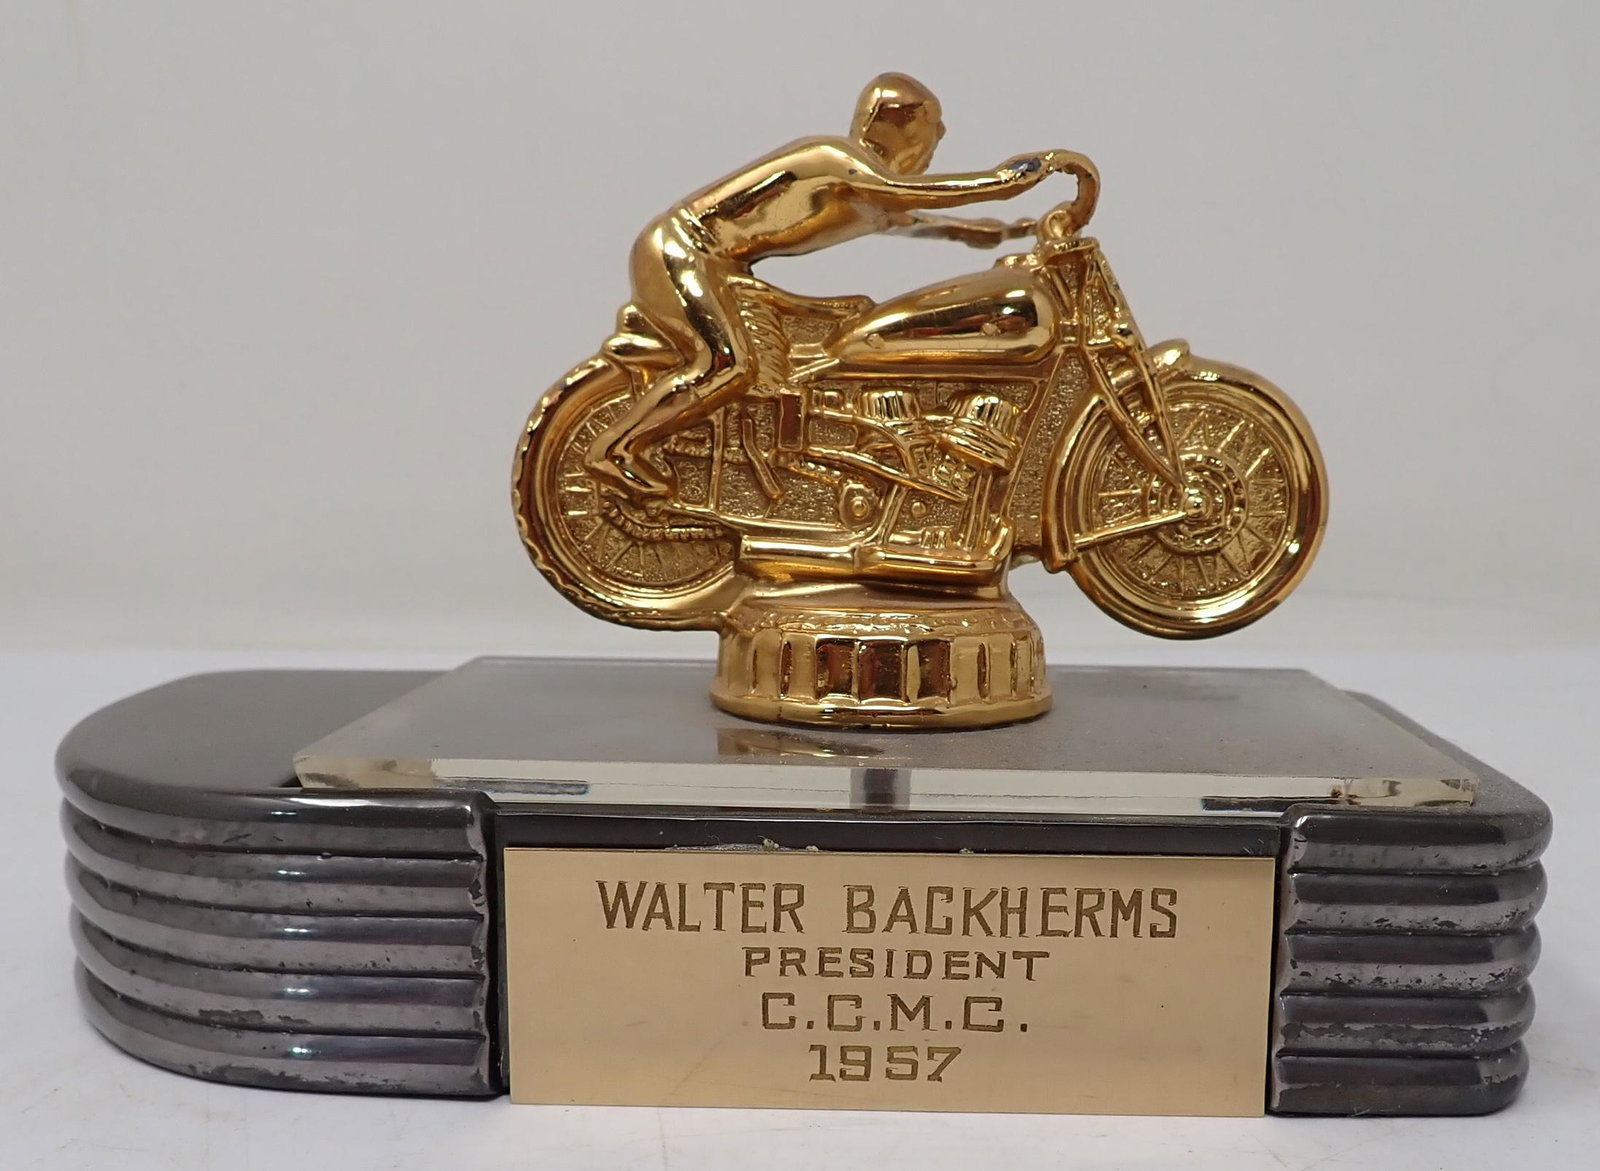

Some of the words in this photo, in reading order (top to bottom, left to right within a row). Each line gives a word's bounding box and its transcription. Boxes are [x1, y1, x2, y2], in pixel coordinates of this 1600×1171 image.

[596, 880, 805, 934] WALTER
[842, 884, 1178, 939] BACKHERMS
[742, 946, 1050, 983] PRESIDENT
[761, 992, 1028, 1033] C.C.M.C.
[808, 1044, 962, 1082] 1957
